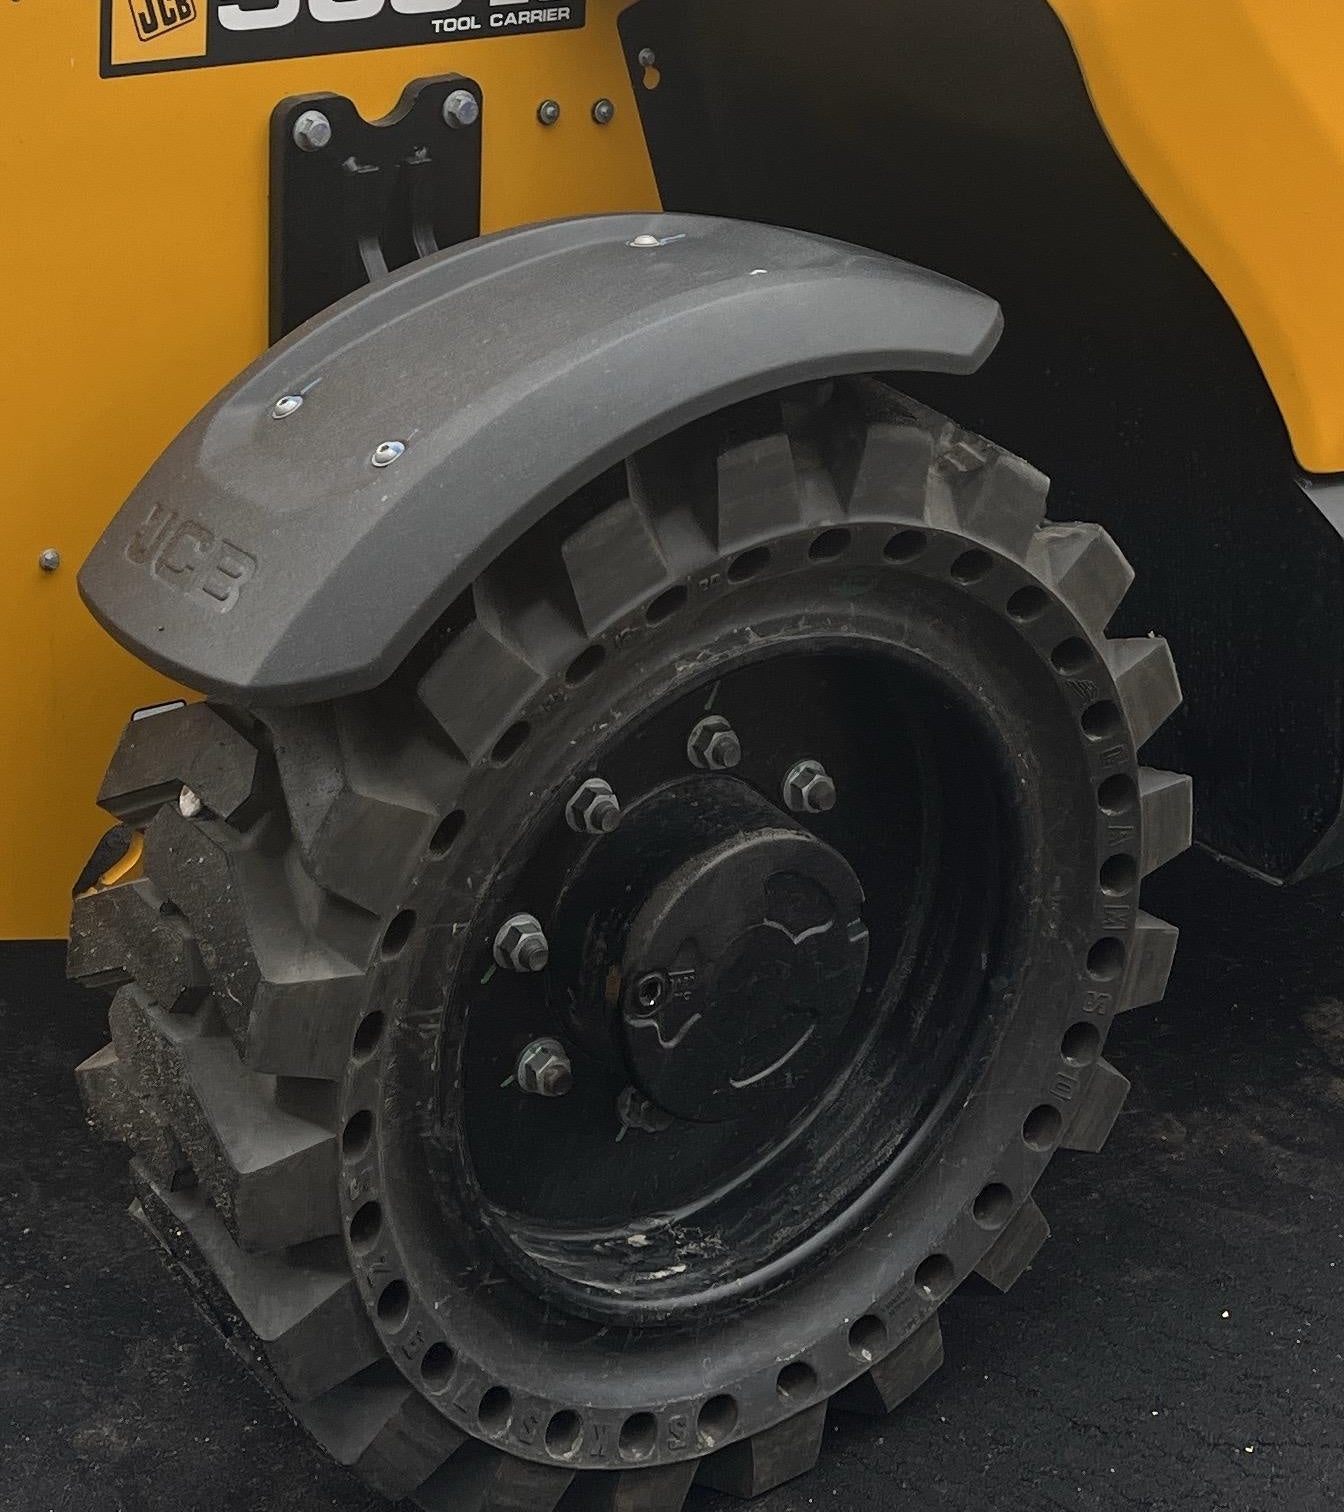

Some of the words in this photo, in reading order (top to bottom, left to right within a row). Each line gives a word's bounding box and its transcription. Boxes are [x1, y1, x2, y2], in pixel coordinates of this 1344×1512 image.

[432, 16, 482, 33] TOOL
[490, 7, 570, 28] CARRIER
[125, 503, 260, 614] JCB
